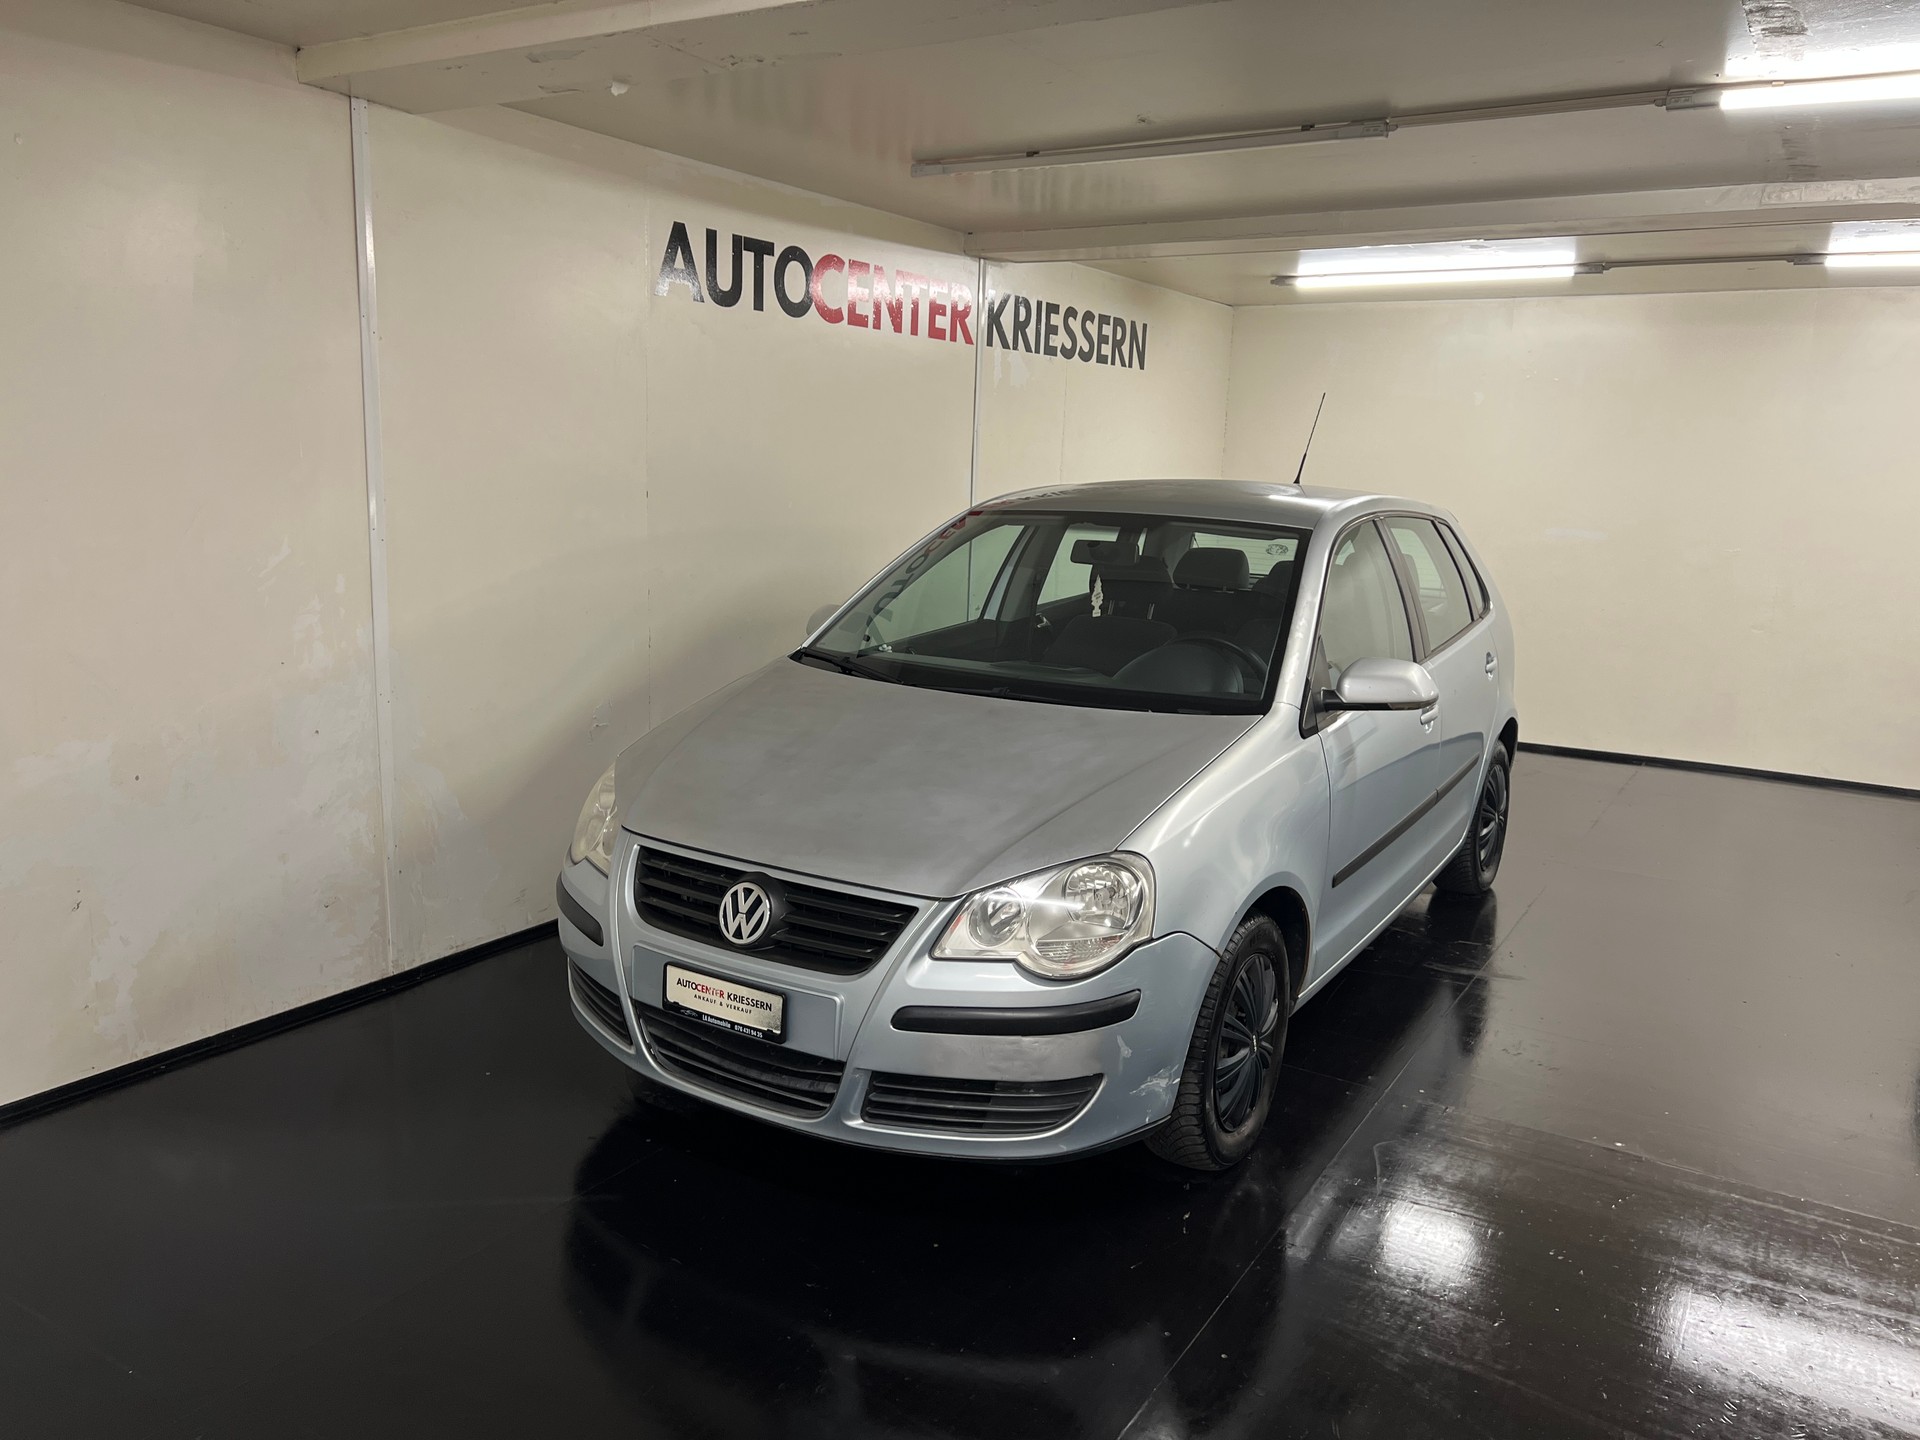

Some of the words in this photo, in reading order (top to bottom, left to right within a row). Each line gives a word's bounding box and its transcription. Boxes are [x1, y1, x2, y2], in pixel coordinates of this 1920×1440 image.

[654, 220, 975, 346] AUTOCENTER
[985, 291, 1149, 371] KRIESSERN
[719, 882, 771, 945] VW
[677, 978, 725, 999] AUTOCENTER
[727, 992, 772, 1011] KRIESSERN
[694, 994, 716, 1004] ANKAUF
[726, 1003, 752, 1014] VERKAUF
